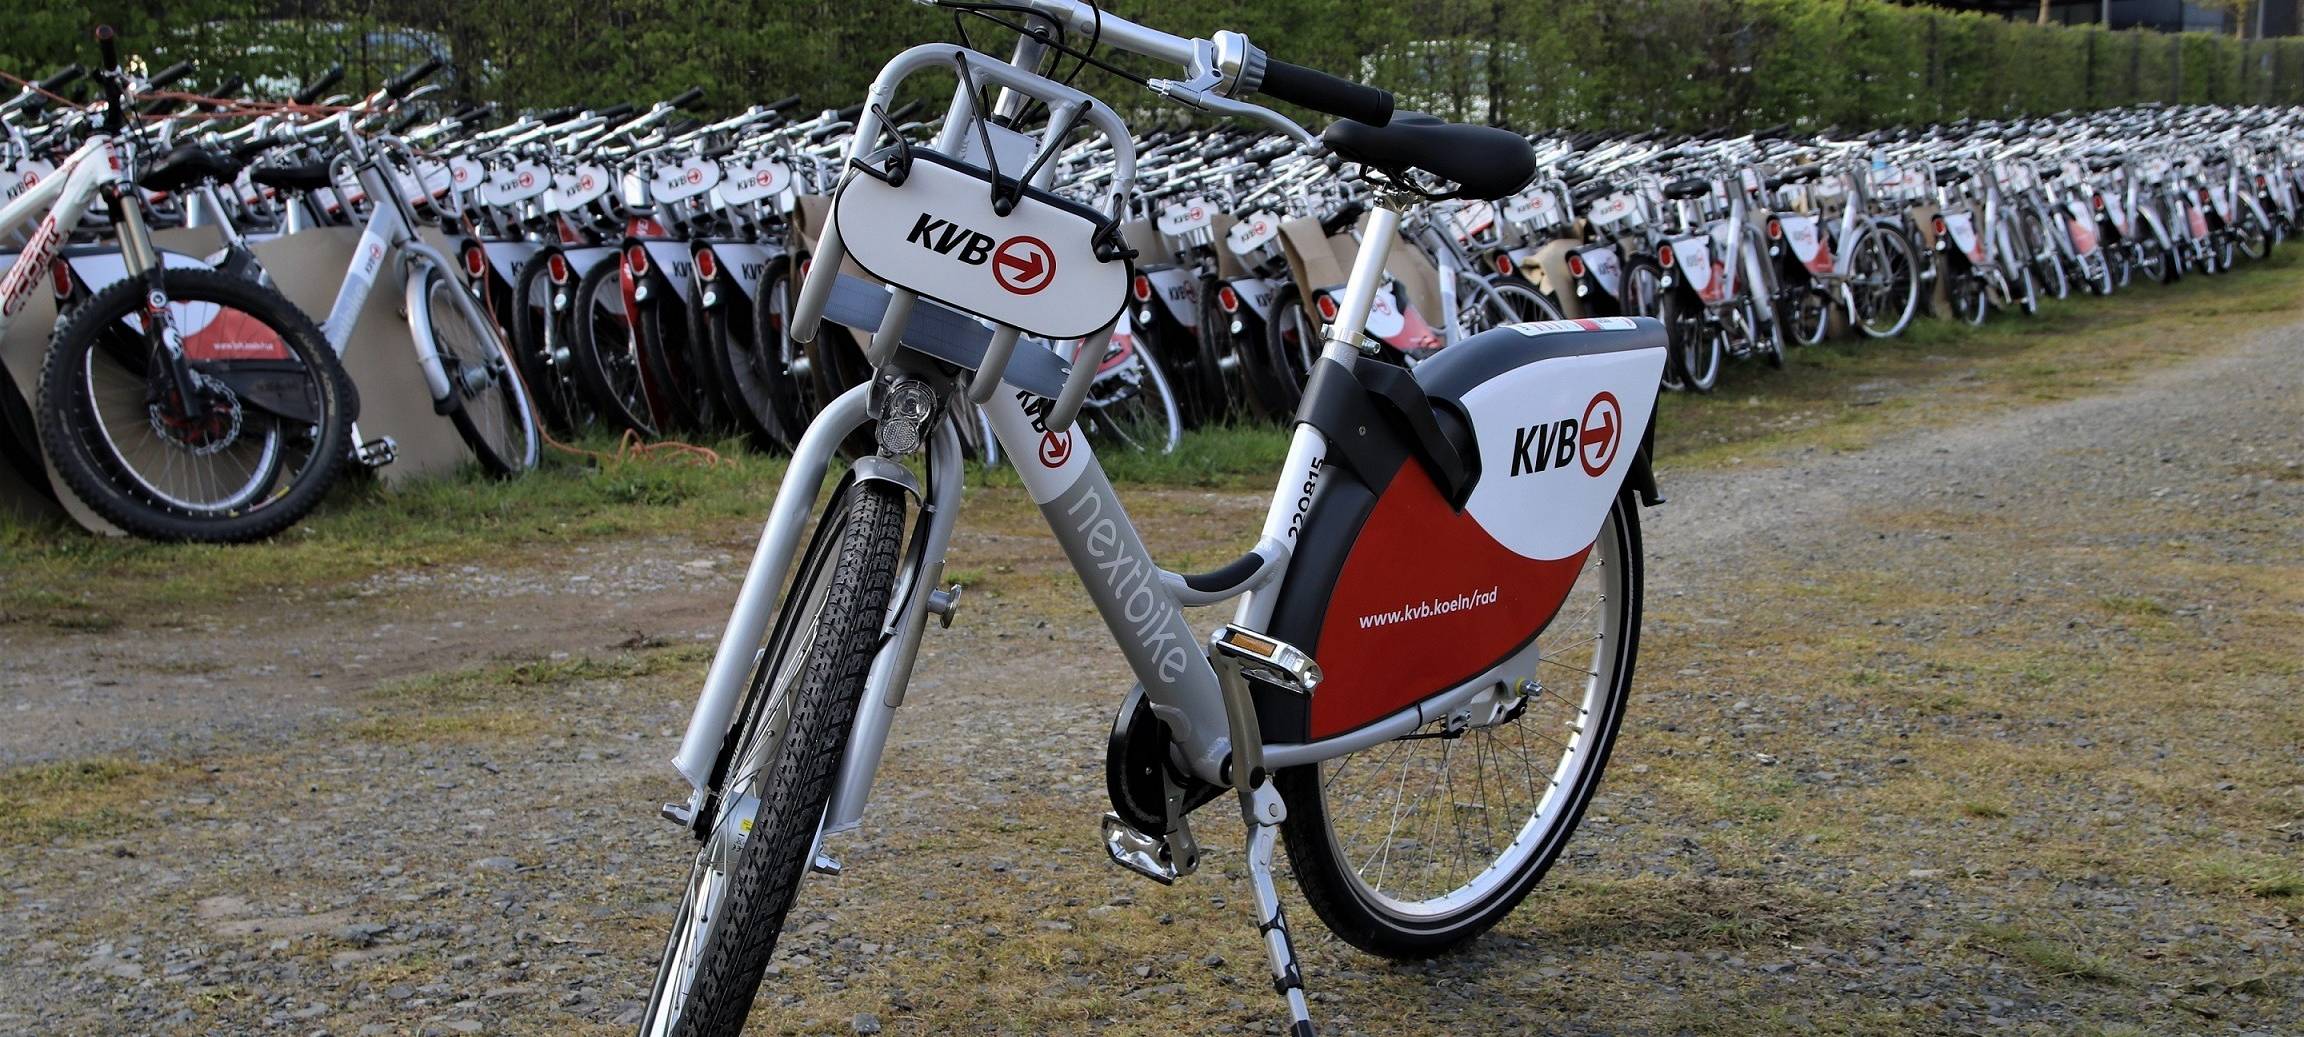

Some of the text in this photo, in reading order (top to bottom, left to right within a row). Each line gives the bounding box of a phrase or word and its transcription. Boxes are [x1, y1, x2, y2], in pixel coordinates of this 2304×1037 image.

[667, 175, 687, 190] KVB
[737, 177, 756, 191] KVB
[906, 212, 996, 266] KVB
[1510, 418, 1579, 477] KVB
[1288, 456, 1325, 542] 220815
[1068, 486, 1188, 684] nextbike
[1359, 586, 1498, 629] www.kvb.koeln/rad
